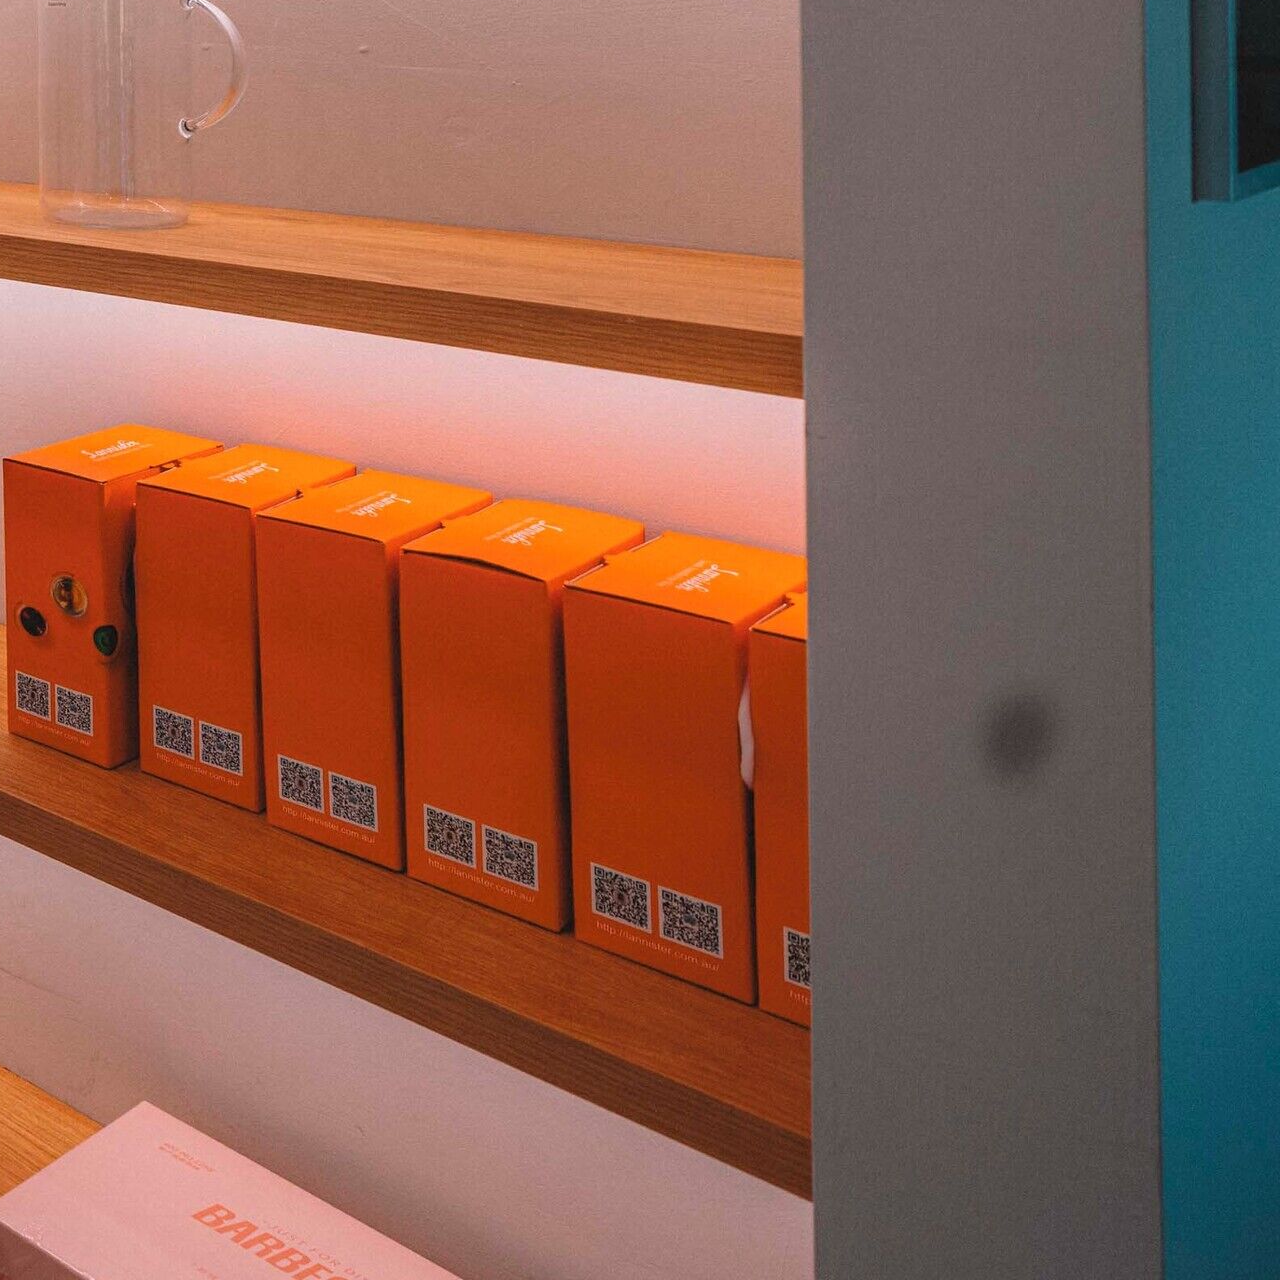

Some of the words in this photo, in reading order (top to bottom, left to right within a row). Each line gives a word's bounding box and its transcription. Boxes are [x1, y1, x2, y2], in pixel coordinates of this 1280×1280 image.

[428, 856, 535, 903] http://lannister.com.au/
[596, 920, 720, 972] http://lannister.com.au/
[192, 1204, 349, 1280] BARBE
